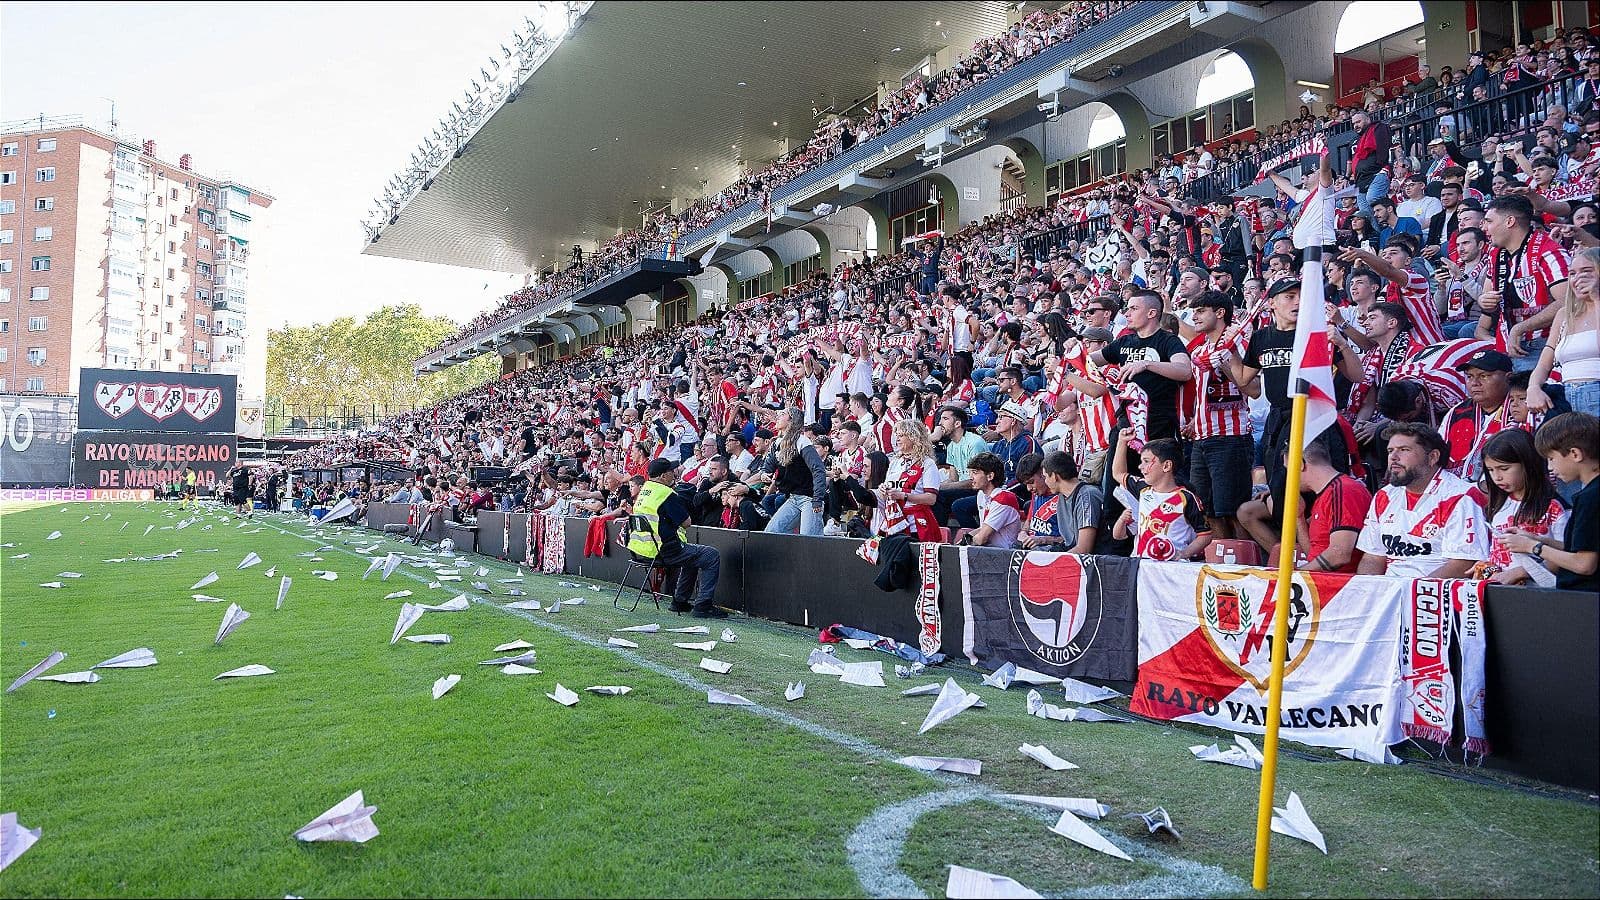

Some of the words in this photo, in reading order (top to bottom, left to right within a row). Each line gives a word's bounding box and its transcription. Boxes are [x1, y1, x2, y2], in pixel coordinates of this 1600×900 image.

[0, 405, 34, 452] 0
[85, 443, 129, 461] RAYO
[135, 444, 231, 462] VALLECANO
[100, 469, 119, 487] DE
[124, 469, 182, 487] MADRID
[94, 490, 137, 501] LALIGA
[923, 588, 936, 625] RAYO
[1037, 642, 1082, 662] AKTION
[1402, 626, 1410, 666] 1924
[1148, 681, 1219, 716] RAYO
